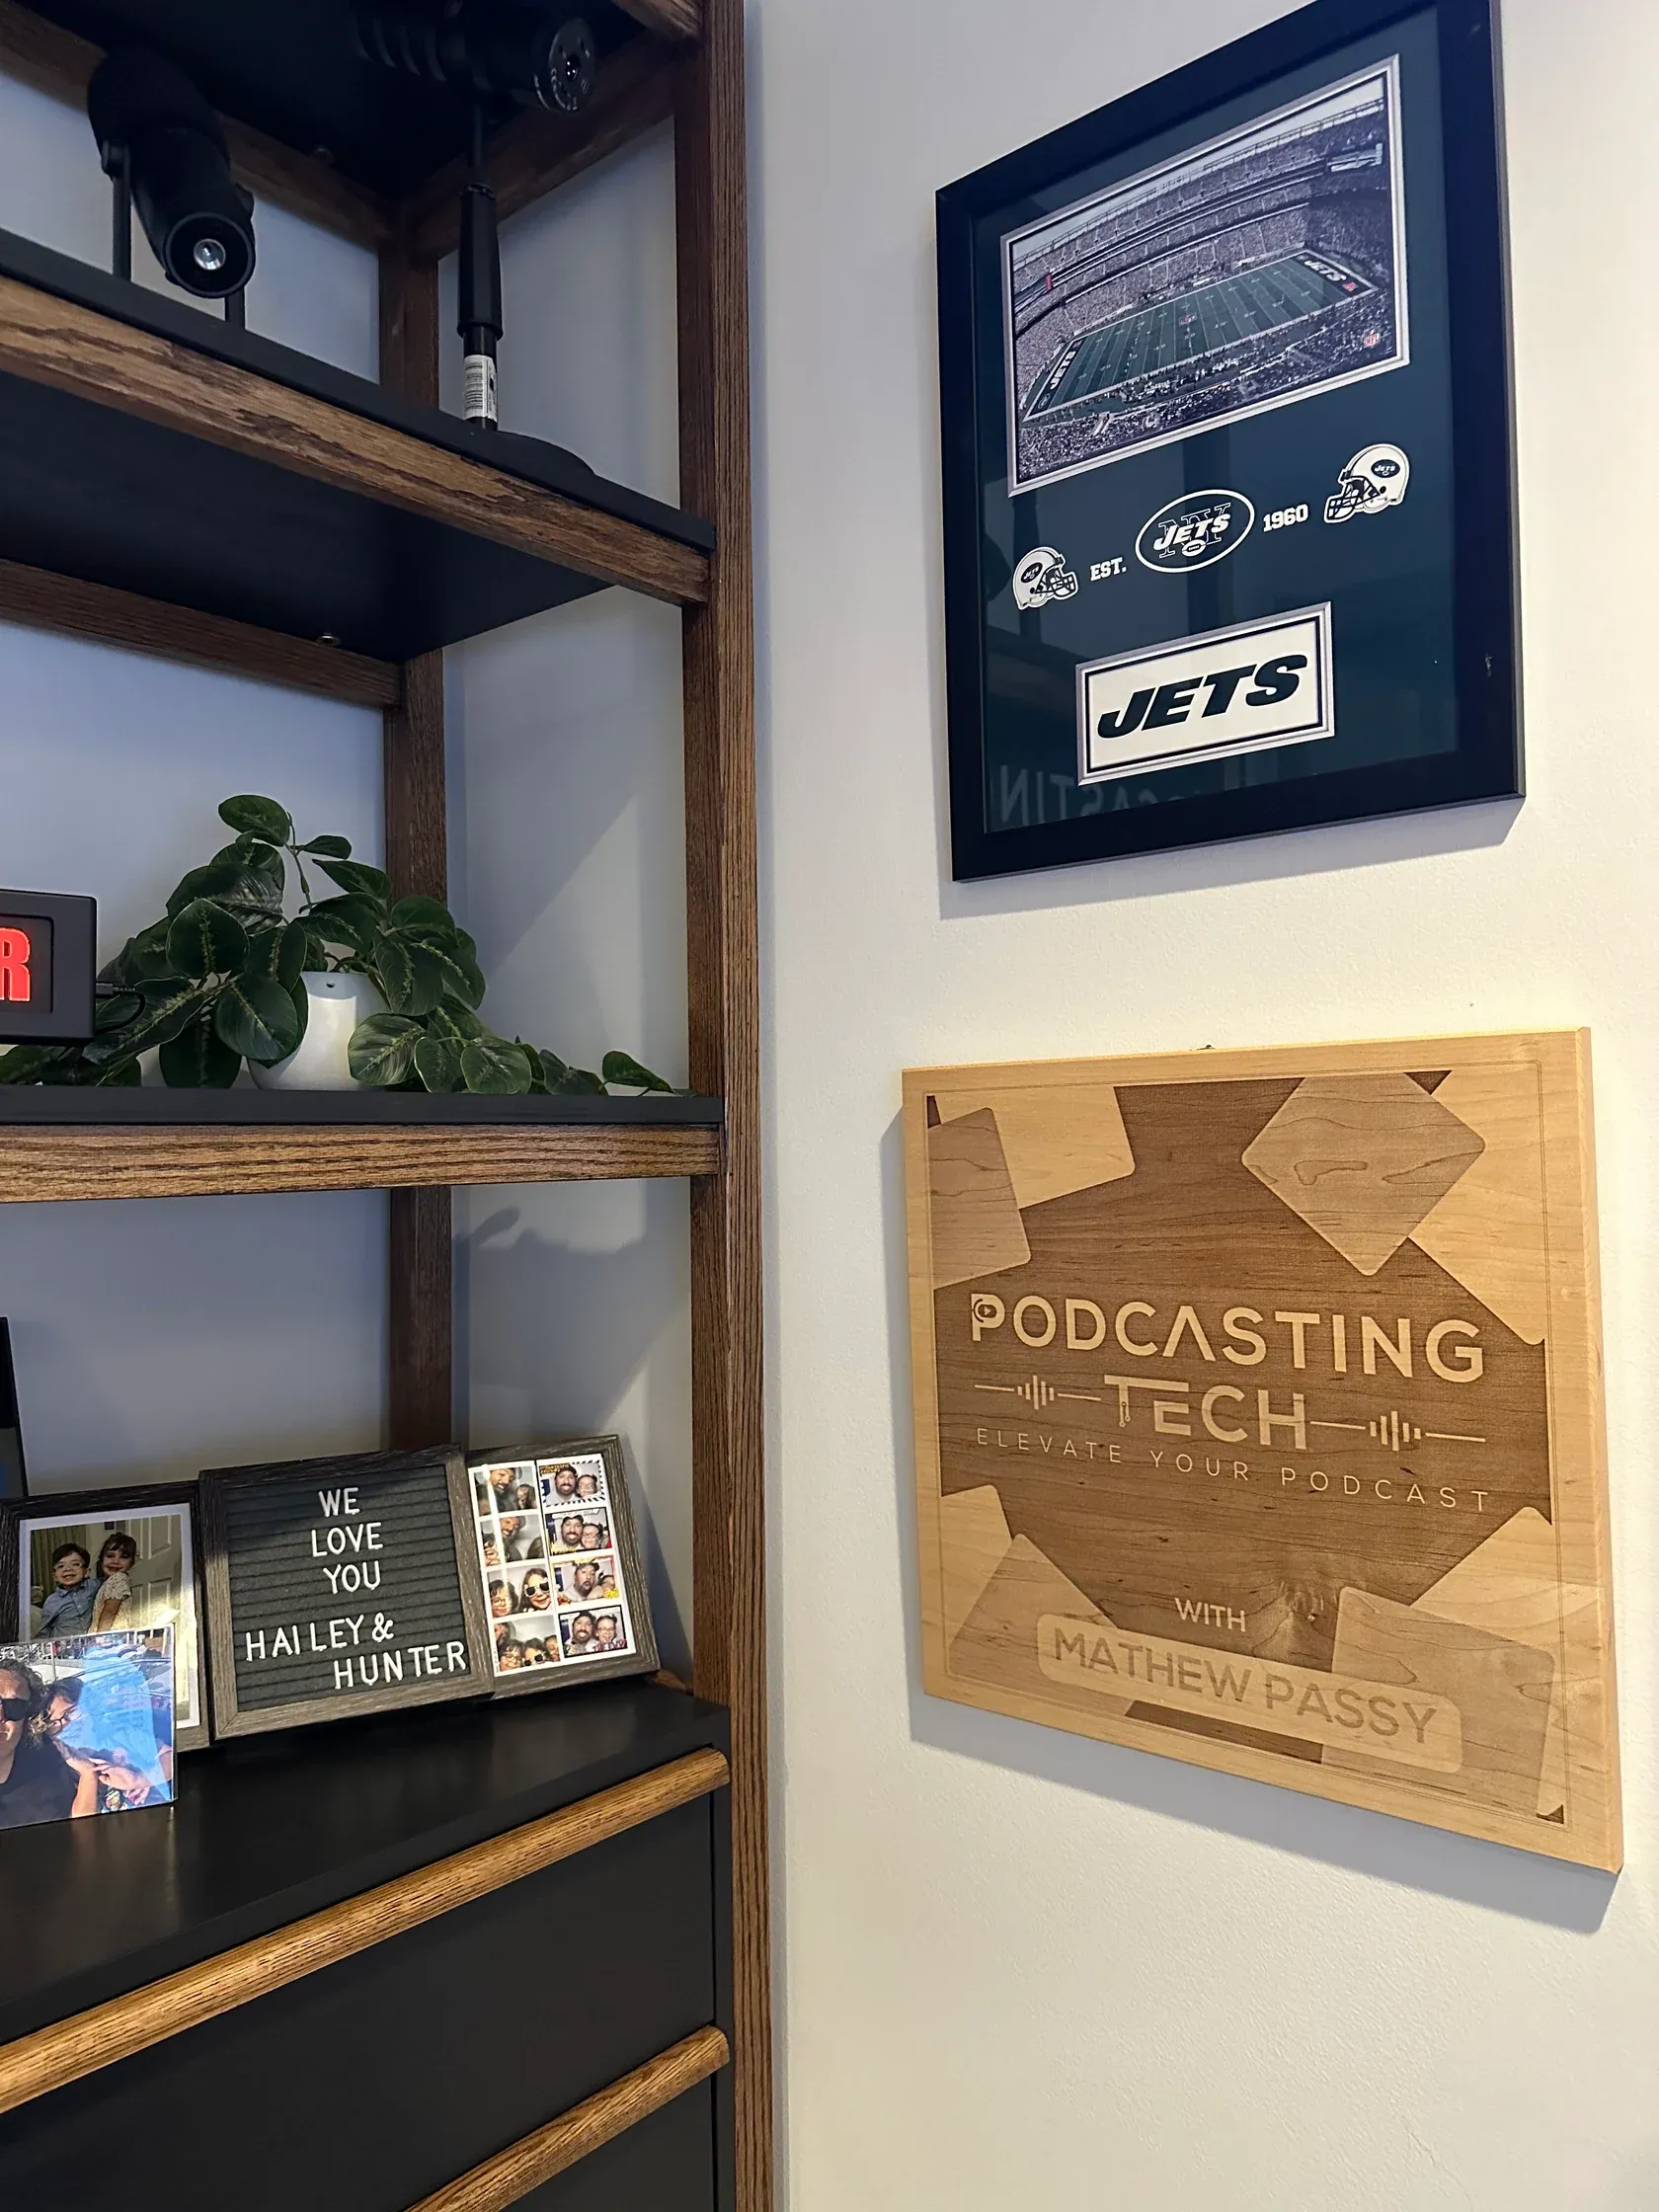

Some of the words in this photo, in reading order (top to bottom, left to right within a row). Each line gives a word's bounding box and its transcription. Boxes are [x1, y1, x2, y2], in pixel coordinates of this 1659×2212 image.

[1152, 513, 1231, 551] JETS
[1263, 504, 1309, 532] 1960
[1089, 557, 1127, 582] EST.
[1097, 654, 1308, 739] JETS
[970, 1293, 1483, 1383] PODCASTING
[1103, 1374, 1307, 1450] TECH
[977, 1428, 1123, 1463] ELEVATE
[1149, 1450, 1249, 1481] YOUR
[1281, 1467, 1488, 1512] PODCAST
[318, 1486, 360, 1518] WE
[311, 1522, 383, 1557] LOVE
[322, 1559, 381, 1595] YOU
[246, 1614, 364, 1662] HAILEY
[371, 1612, 394, 1642] &
[1174, 1597, 1246, 1633] WITH
[333, 1640, 467, 1690] HUNTER
[1054, 1626, 1253, 1702] MATHEW
[1266, 1677, 1438, 1744] PASSY
